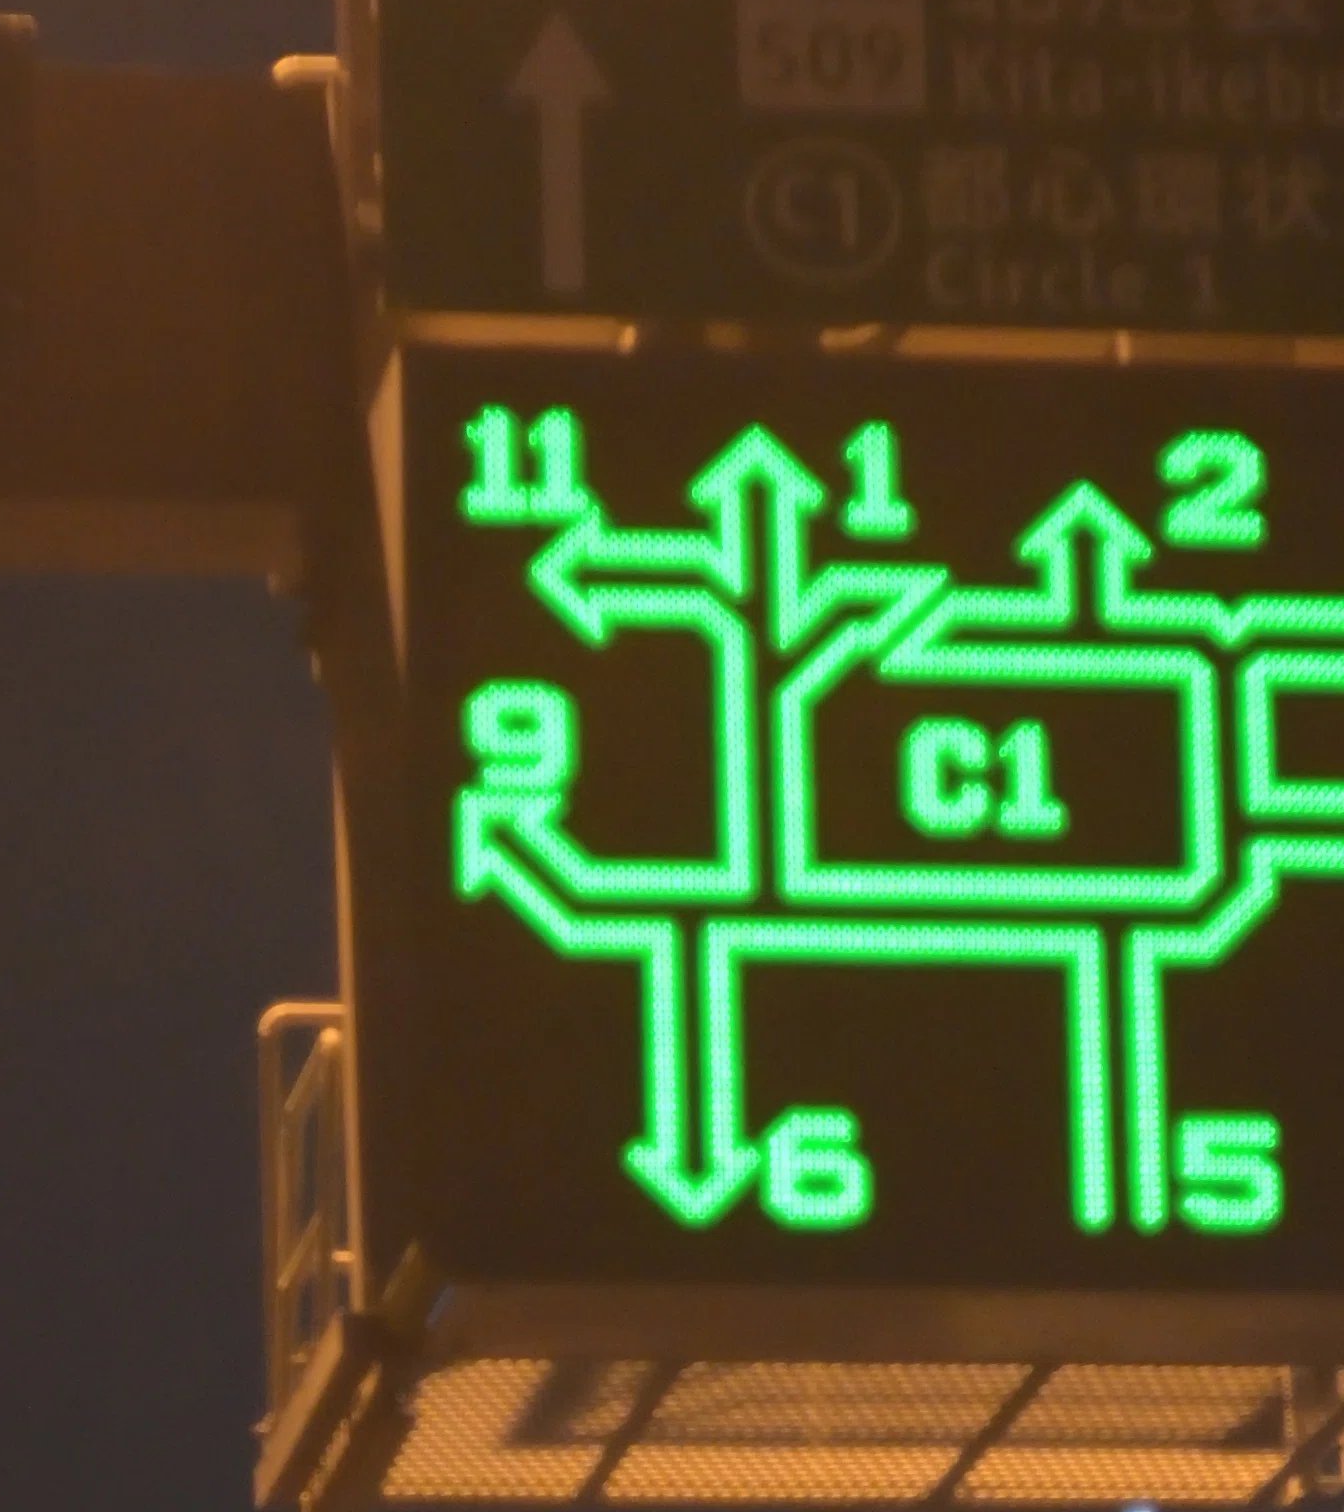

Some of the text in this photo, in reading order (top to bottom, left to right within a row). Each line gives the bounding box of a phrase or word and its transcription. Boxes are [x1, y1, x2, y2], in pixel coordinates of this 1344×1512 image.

[774, 170, 861, 249] C1
[925, 248, 1219, 317] Circle 1
[461, 404, 593, 524] 11
[841, 421, 916, 535] 1
[1160, 428, 1268, 548] 2
[463, 680, 576, 788] 9
[900, 717, 1067, 836] C1
[758, 1108, 872, 1227] 6
[1174, 1114, 1284, 1229] 5
